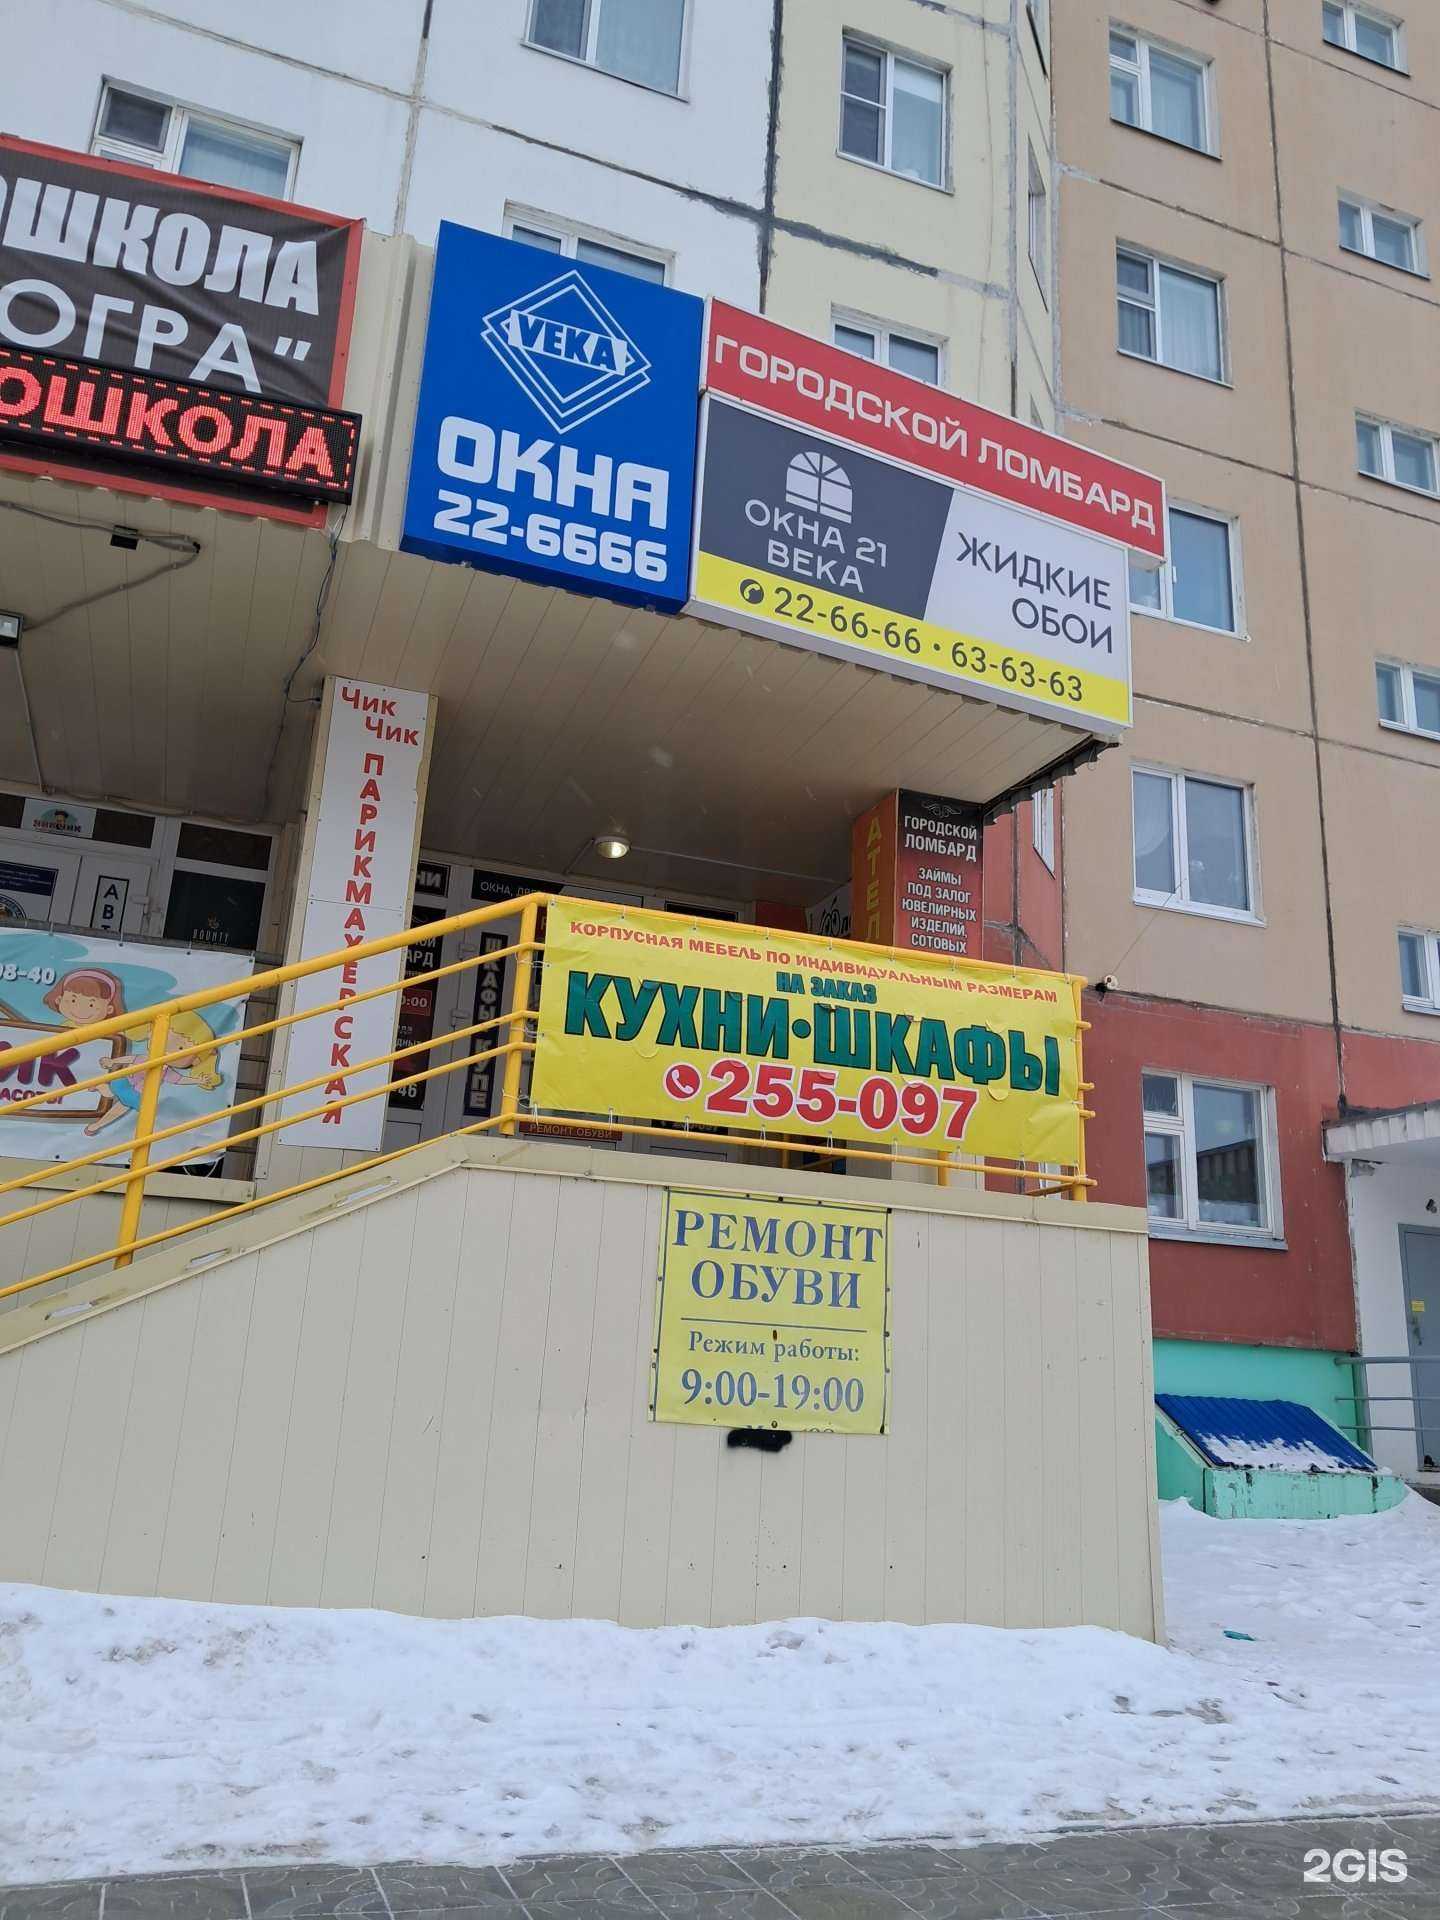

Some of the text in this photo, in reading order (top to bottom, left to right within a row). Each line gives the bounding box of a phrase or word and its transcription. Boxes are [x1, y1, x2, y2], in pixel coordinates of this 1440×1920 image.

[0, 174, 320, 316] ШКОЛА
[516, 313, 618, 372] VEKA
[714, 334, 1156, 536] ГОРОДСКОЙ ЛОМБАРД
[437, 415, 670, 530] ОКНА
[433, 489, 668, 582] 22-6666
[744, 498, 887, 568] ОКНА 21
[766, 540, 864, 593] ВЕКА
[956, 531, 1112, 610] ЖИДКИЕ
[774, 586, 1083, 702] 22-66-66 63-63-63
[1011, 597, 1113, 653] ОБОИ
[904, 815, 977, 841] ГОРОДСКОЙ
[905, 833, 977, 863] ЛОМБАРД
[907, 882, 972, 904] ПОД ЗАЛОГ
[918, 867, 962, 886] ЗАЙМЫ
[902, 898, 977, 922] ЮВЕЛИРНЫХ
[911, 915, 968, 938] ИЗДЕЛИЙ,
[569, 921, 684, 950] КОРПУСНАЯ
[689, 936, 761, 963] МЕБЕЛЬ
[766, 949, 791, 965] ПО
[796, 953, 963, 991] ИНДИВИДУАЛЬНЫМ
[967, 980, 1058, 1003] РАЗМЕРАМ
[911, 934, 967, 954] СОТОВЫХ
[0, 962, 56, 986] 8-40
[776, 971, 877, 1005] НА ЗАКАЗ
[705, 1059, 979, 1140] 255-097
[529, 1124, 576, 1136] РЕМОНТ
[672, 1209, 883, 1263] РЕМОНТ
[691, 1260, 862, 1309] ОБУВИ
[689, 1331, 859, 1362] Режим работы:
[681, 1368, 864, 1412] 9:00-19:00
